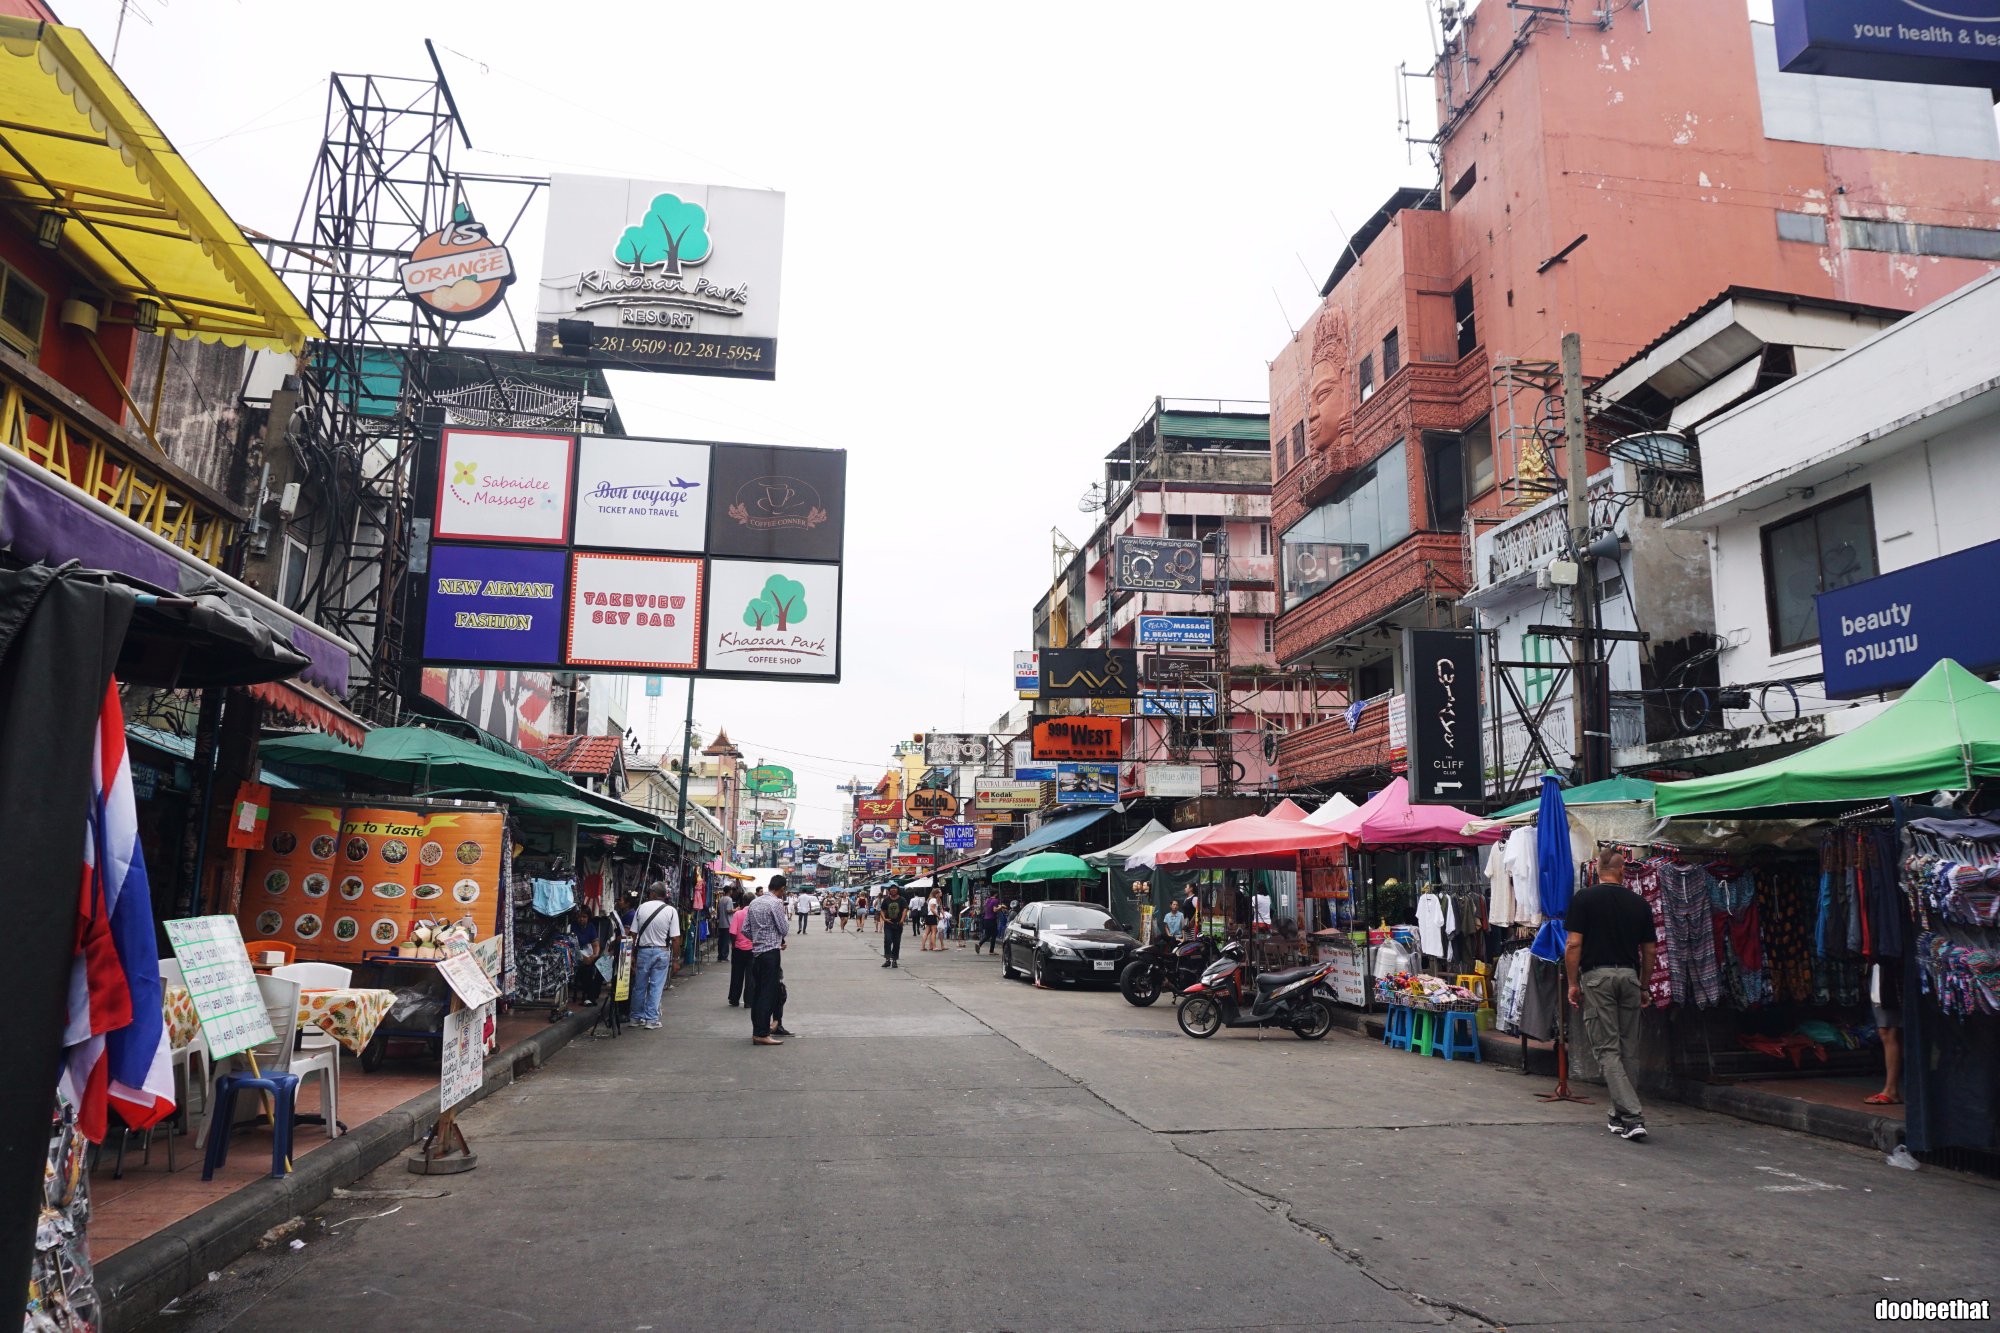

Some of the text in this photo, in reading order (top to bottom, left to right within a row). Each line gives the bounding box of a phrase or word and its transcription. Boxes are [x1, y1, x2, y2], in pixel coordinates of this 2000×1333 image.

[1854, 23, 1893, 38] your
[1898, 24, 1952, 43] health
[1958, 29, 1971, 44] &
[439, 221, 484, 246] IS
[408, 254, 504, 285] ORANGE
[575, 270, 748, 304] Khaosan Park
[621, 308, 694, 329] RESORT
[482, 475, 551, 490] Sabaidee
[474, 491, 535, 509] Massage
[595, 480, 688, 507] Bon voyage
[598, 505, 679, 517] TICKET AND TRAVEL
[750, 518, 807, 528] COFFEE CONNER
[438, 578, 555, 599] NEW ARMANI
[584, 592, 686, 609] TAKEVIEW
[454, 611, 533, 631] FASHION
[592, 610, 676, 627] SKY BAR
[1841, 602, 1912, 637] beauty
[718, 631, 826, 652] Khaosan Park
[1845, 633, 1919, 666] ความงาม
[747, 656, 802, 665] COFFEE SHOP
[1145, 701, 1153, 709] &
[1048, 722, 1113, 746] 999 WEST
[1077, 764, 1101, 773] Pillow
[1433, 760, 1465, 769] CLIFF
[863, 800, 896, 812] Roof
[914, 794, 948, 810] Buddy
[362, 820, 378, 834] to
[385, 821, 424, 838] taste
[944, 827, 956, 838] SIM
[957, 827, 974, 838] CARD
